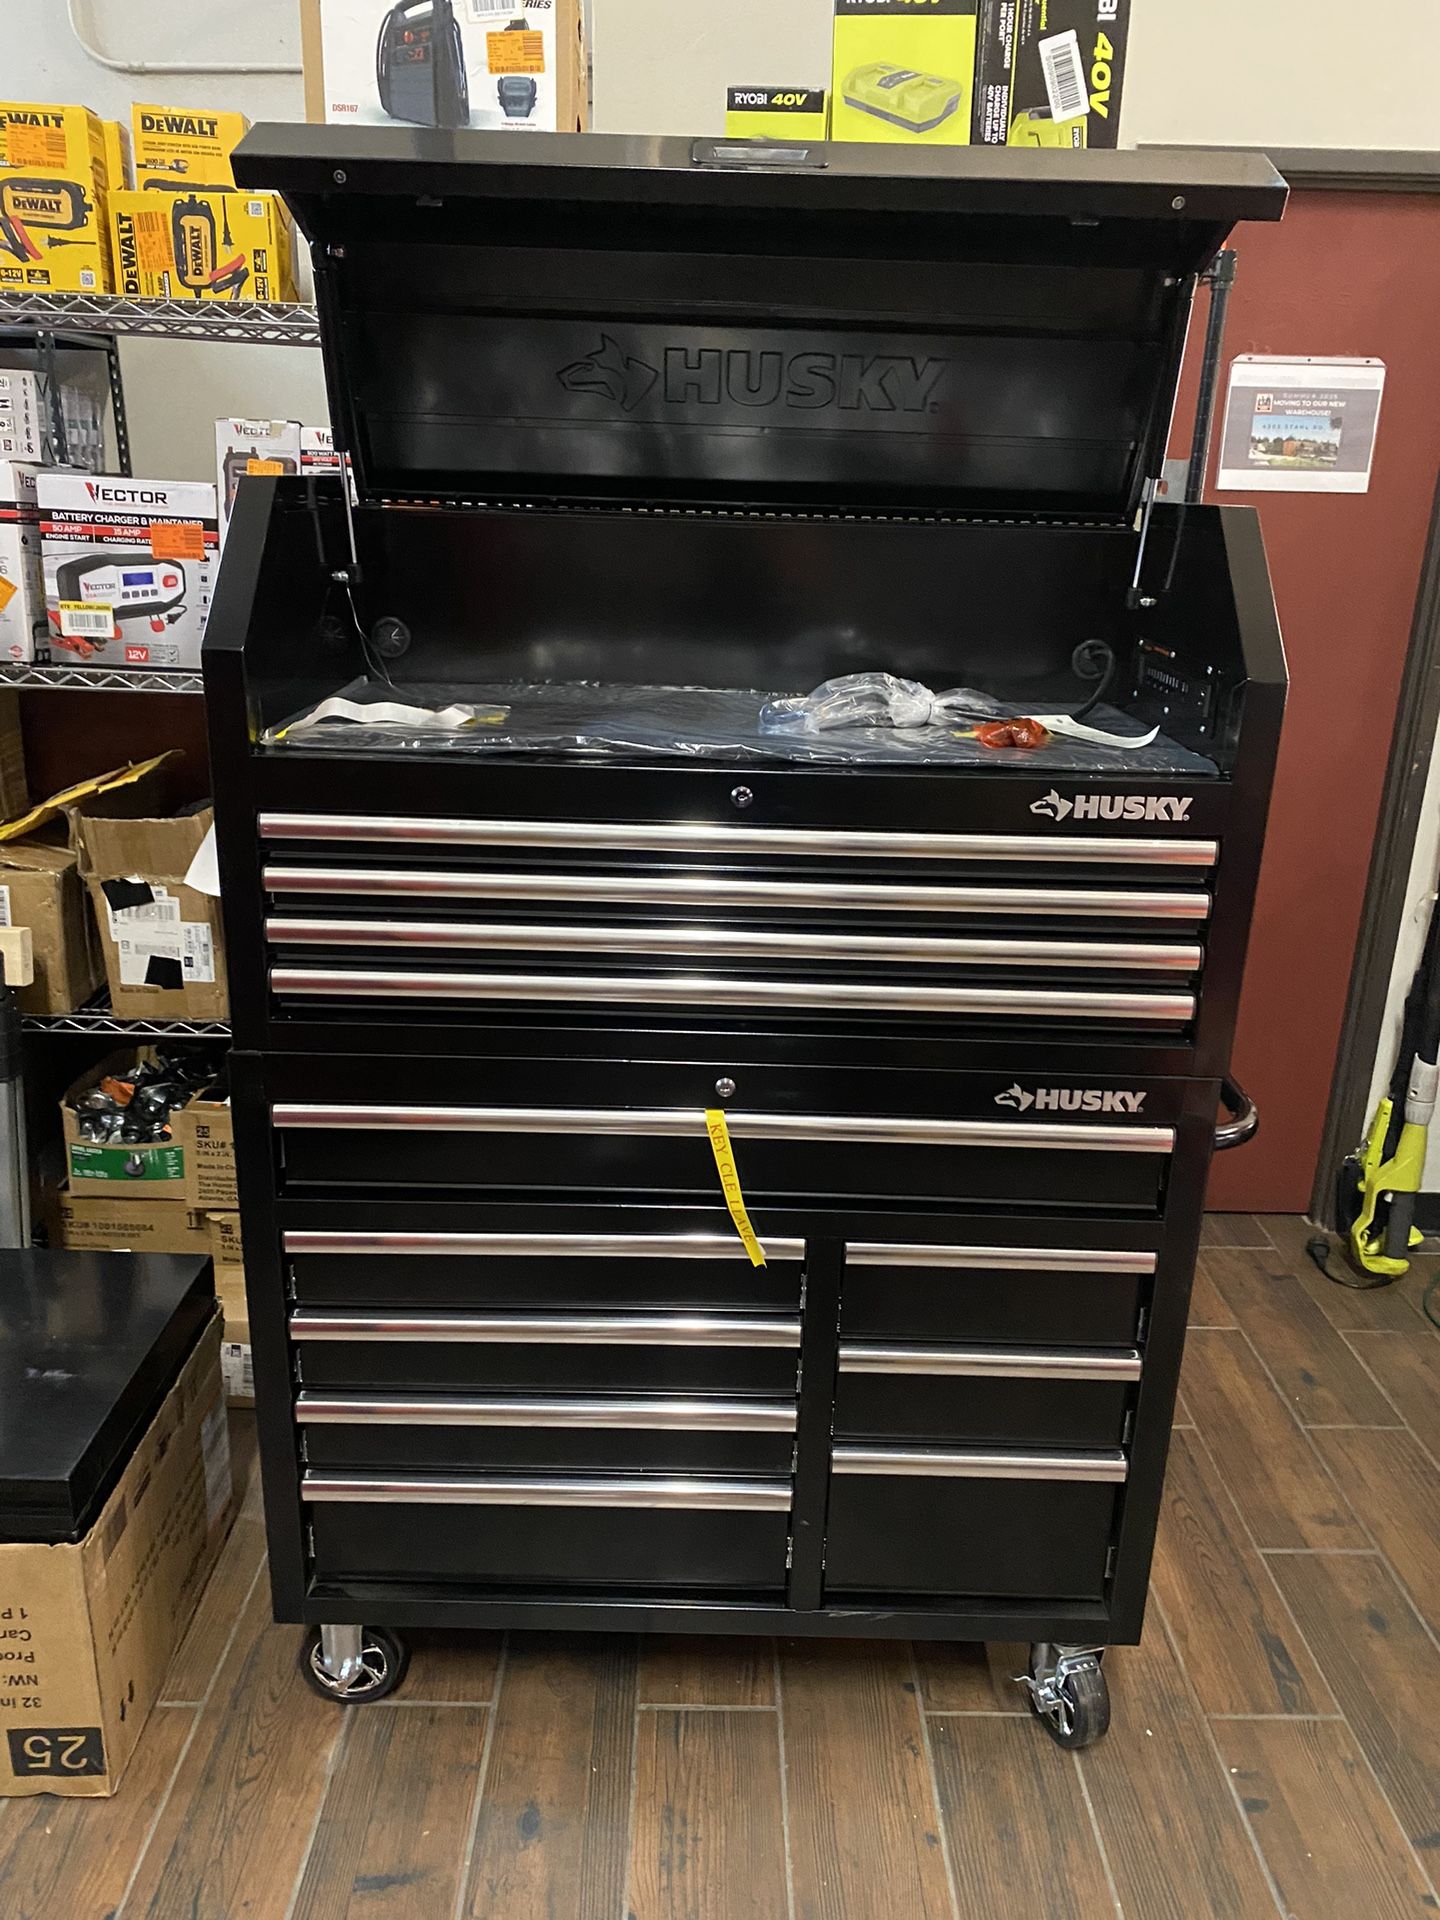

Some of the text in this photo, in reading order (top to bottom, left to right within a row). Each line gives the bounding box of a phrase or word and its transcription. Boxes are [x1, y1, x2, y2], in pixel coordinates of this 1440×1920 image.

[1089, 32, 1114, 119] 40V
[735, 93, 808, 106] RYOBI 40V
[664, 347, 947, 413] HUSKY
[84, 482, 168, 505] VECTOR
[51, 511, 93, 523] BATTERY
[94, 514, 140, 526] CHARGER
[64, 525, 83, 533] AMP
[124, 529, 141, 537] AMP
[102, 536, 136, 544] CHARGING
[126, 650, 147, 660] 12V
[1073, 795, 1194, 821] HUSKY
[1035, 1088, 1147, 1113] HUSKY
[709, 1123, 729, 1155] KEY
[729, 1199, 755, 1243] LLAVE
[2, 1674, 39, 1686] NW:
[22, 1697, 42, 1708] 32
[23, 1734, 89, 1770] 25
